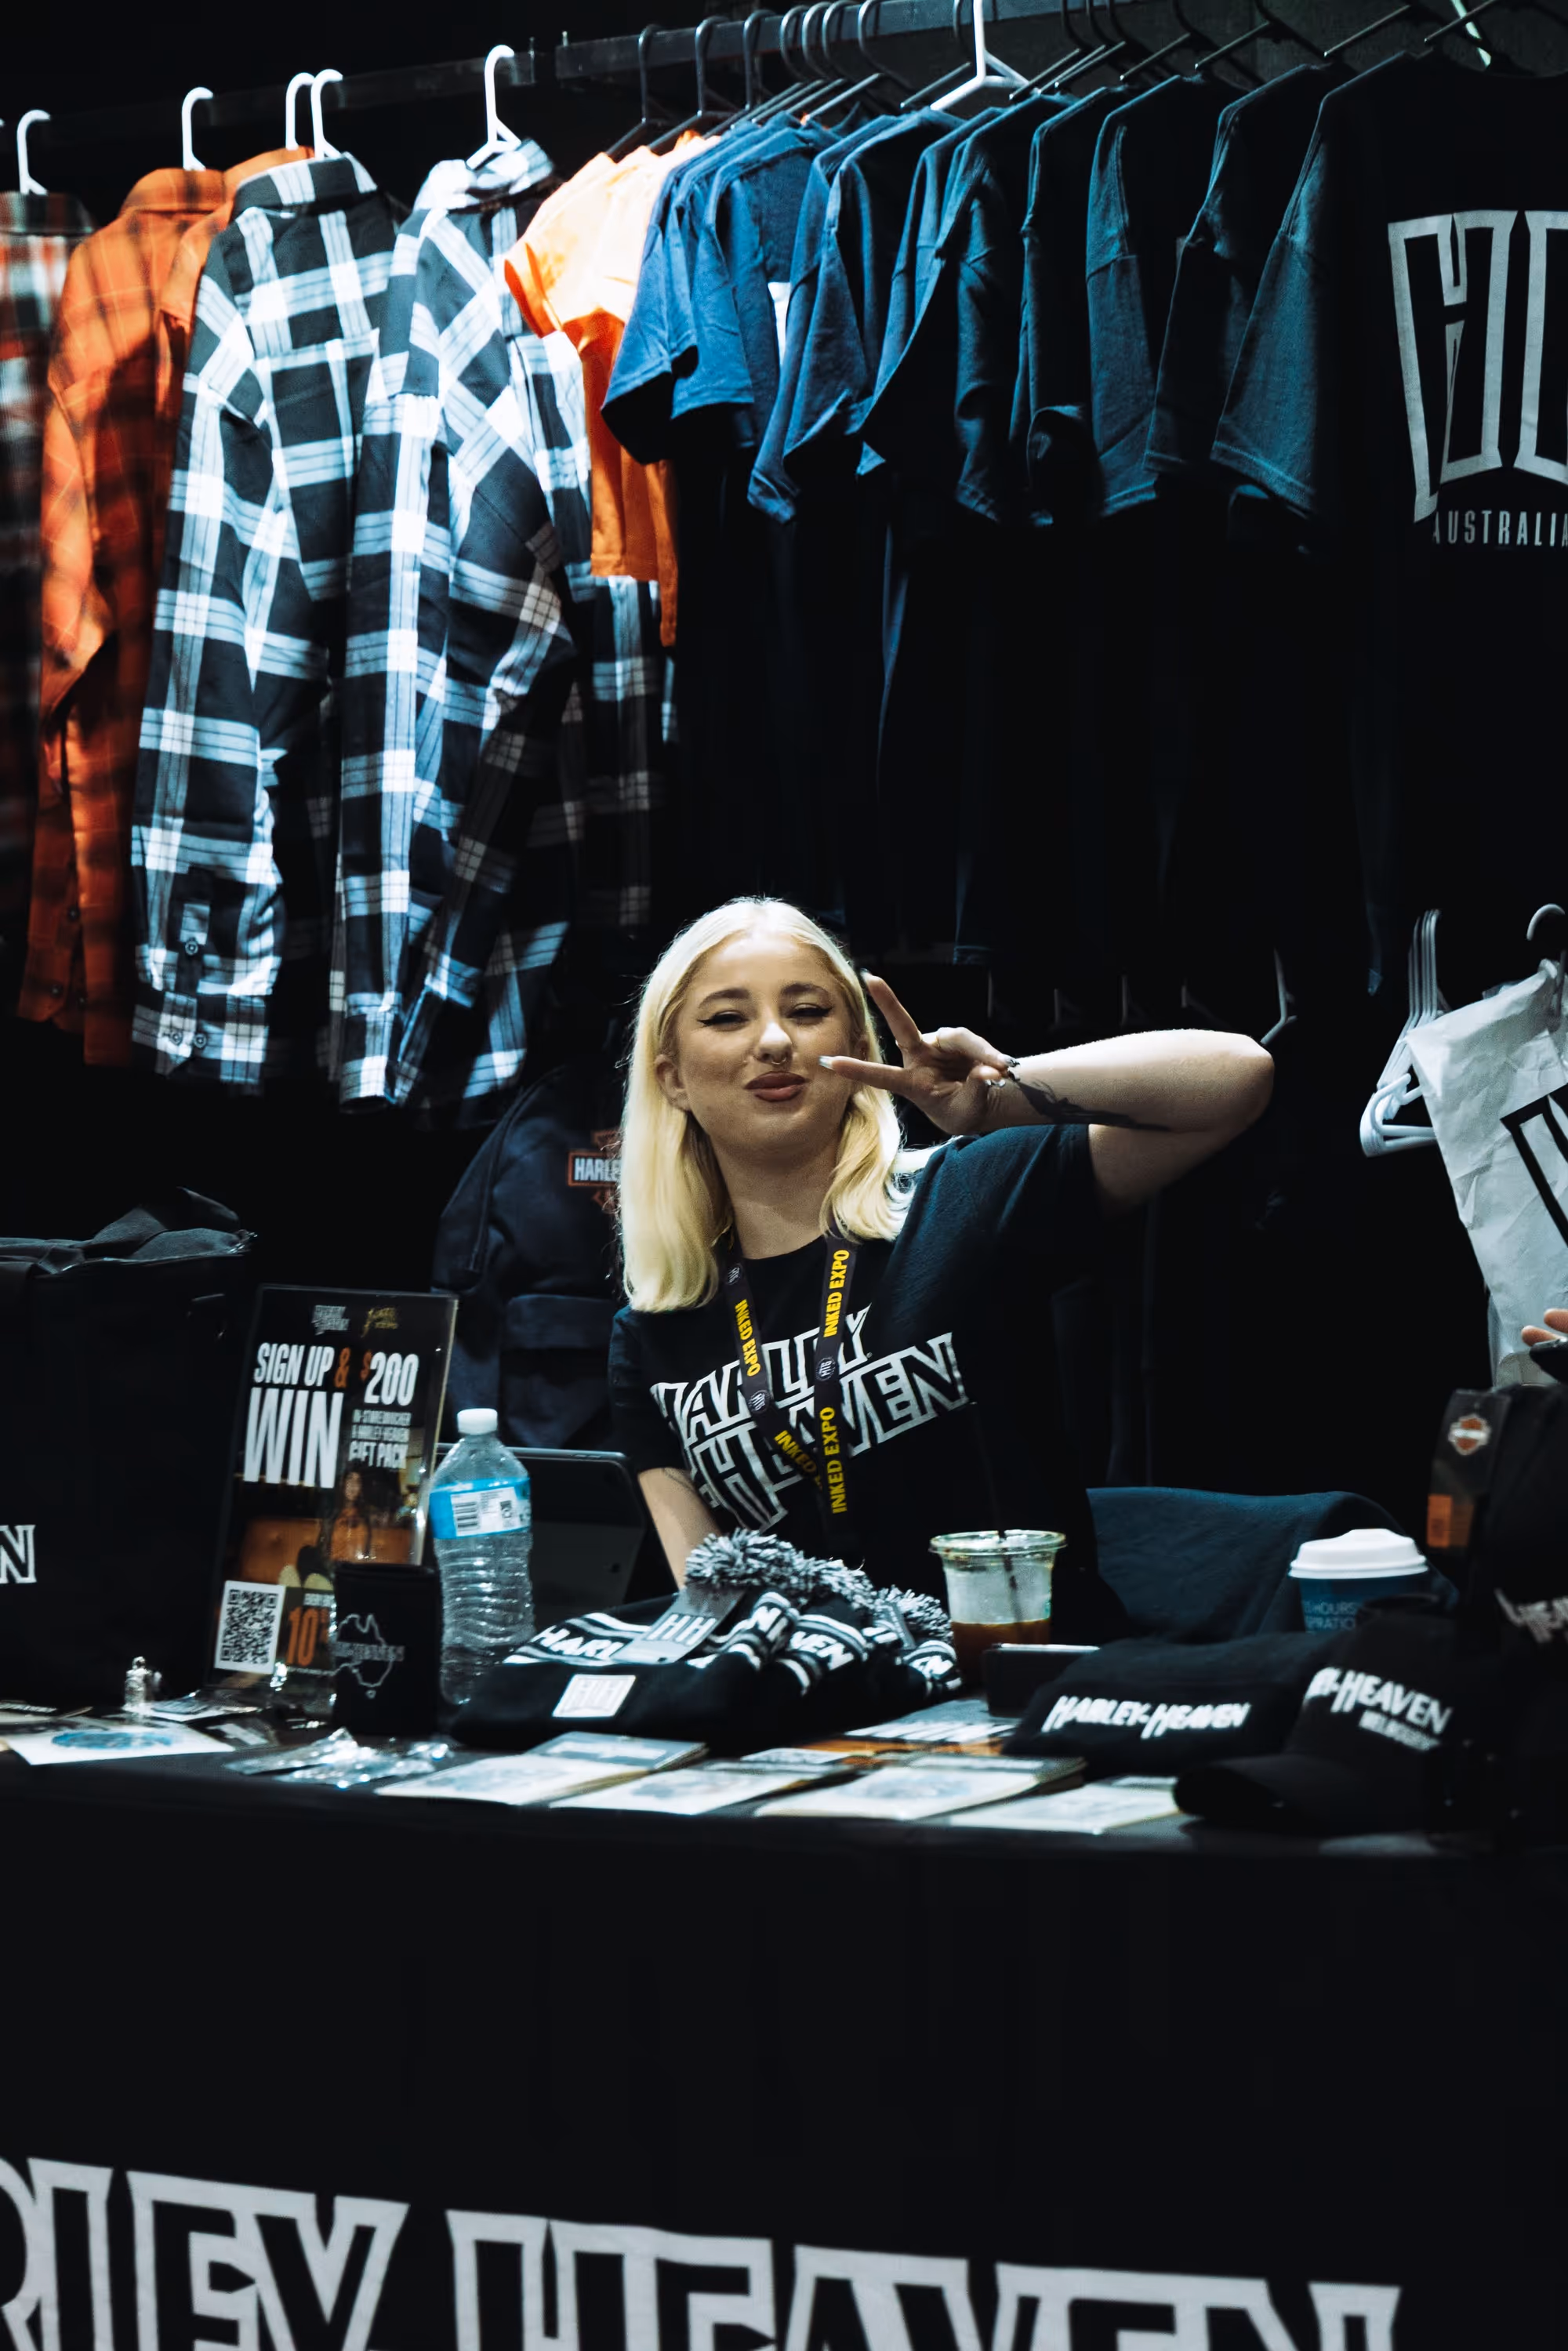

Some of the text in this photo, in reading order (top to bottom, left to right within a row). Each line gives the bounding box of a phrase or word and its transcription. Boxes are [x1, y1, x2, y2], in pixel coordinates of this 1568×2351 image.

[823, 1250, 850, 1337] INKED EXPO
[254, 1342, 351, 1388] SIGN UP &
[735, 1299, 761, 1377] INKED EXPO
[243, 1387, 344, 1489] WIN
[774, 1430, 817, 1473] INKED
[819, 1406, 848, 1514] INKED EXPO
